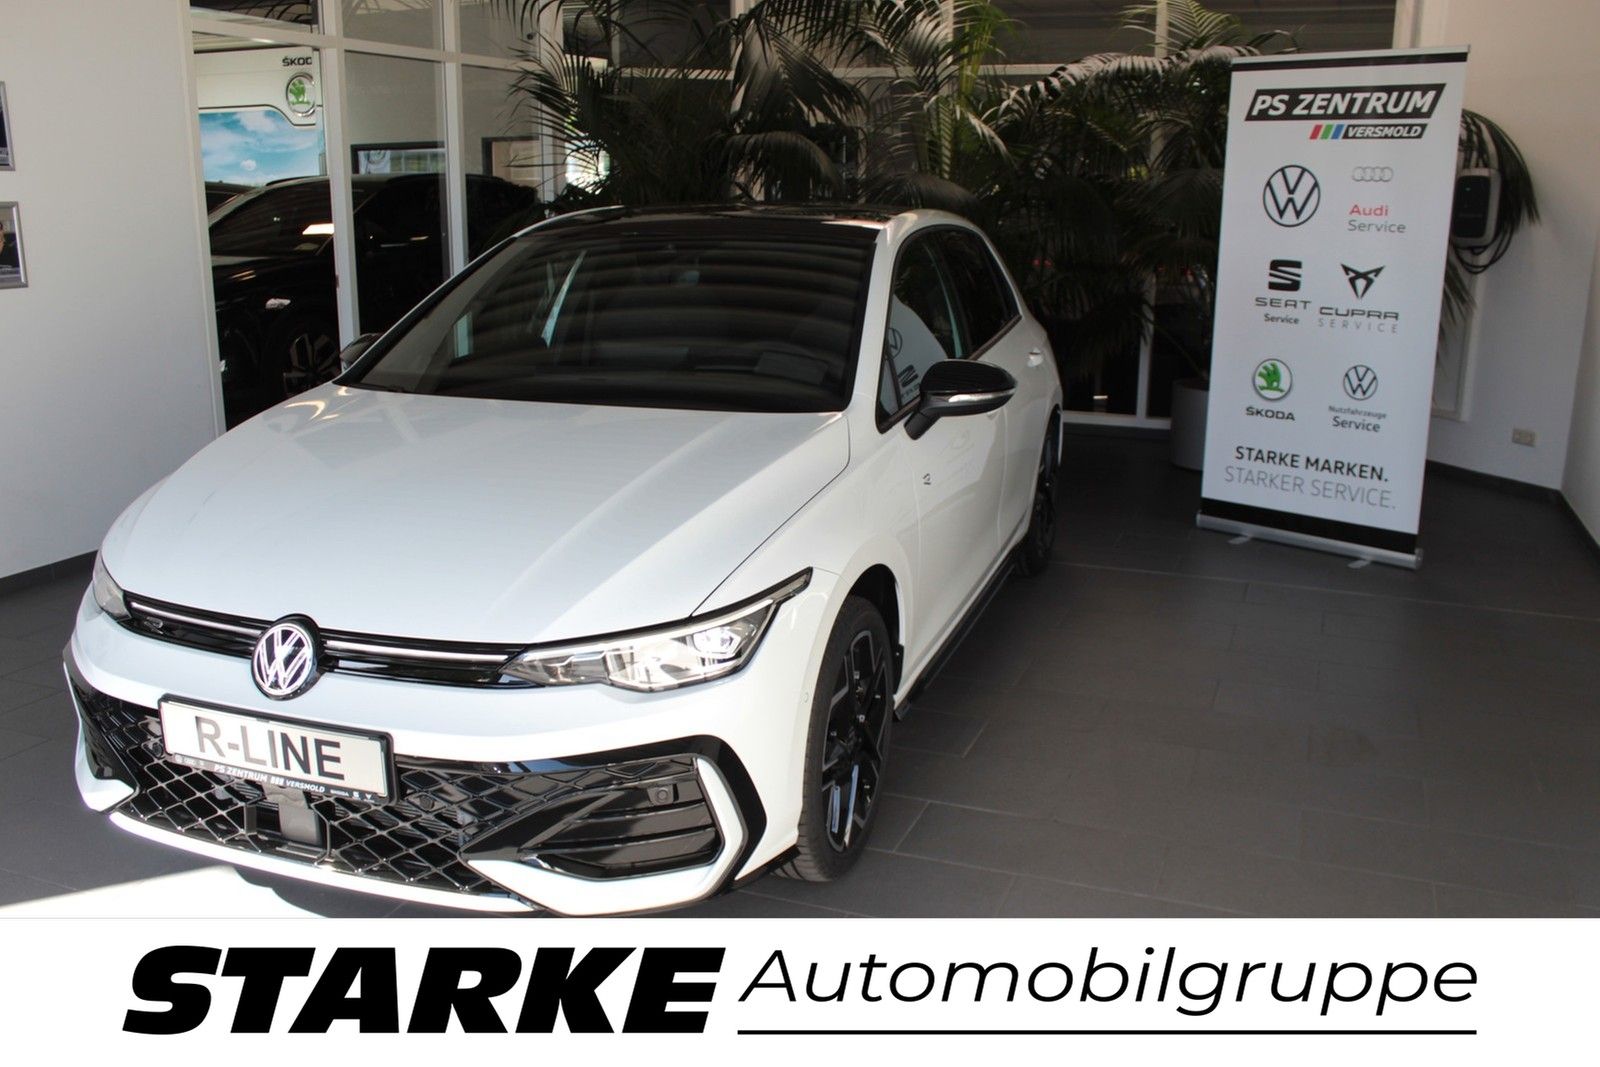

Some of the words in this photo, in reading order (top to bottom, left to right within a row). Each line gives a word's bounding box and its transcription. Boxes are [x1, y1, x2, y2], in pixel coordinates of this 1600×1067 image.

[1251, 94, 1290, 116] PS
[1292, 90, 1436, 115] ZENTRUM
[1348, 126, 1422, 138] VERSMOLD
[1349, 204, 1389, 217] Audi
[1347, 219, 1407, 233] Service
[1255, 296, 1312, 310] SEAT
[1264, 312, 1300, 325] Service
[1319, 306, 1399, 321] CUPRA
[1318, 318, 1399, 334] SERVICE
[1332, 415, 1381, 433] Service
[1235, 445, 1301, 468] STARKE
[1305, 456, 1389, 482] MARKEN.
[1224, 465, 1305, 494] STARKER
[1310, 478, 1396, 510] SERVICE.
[195, 715, 345, 781] R-LINE
[227, 766, 268, 782] ZENTRUM
[286, 779, 325, 793] VERSMOLD
